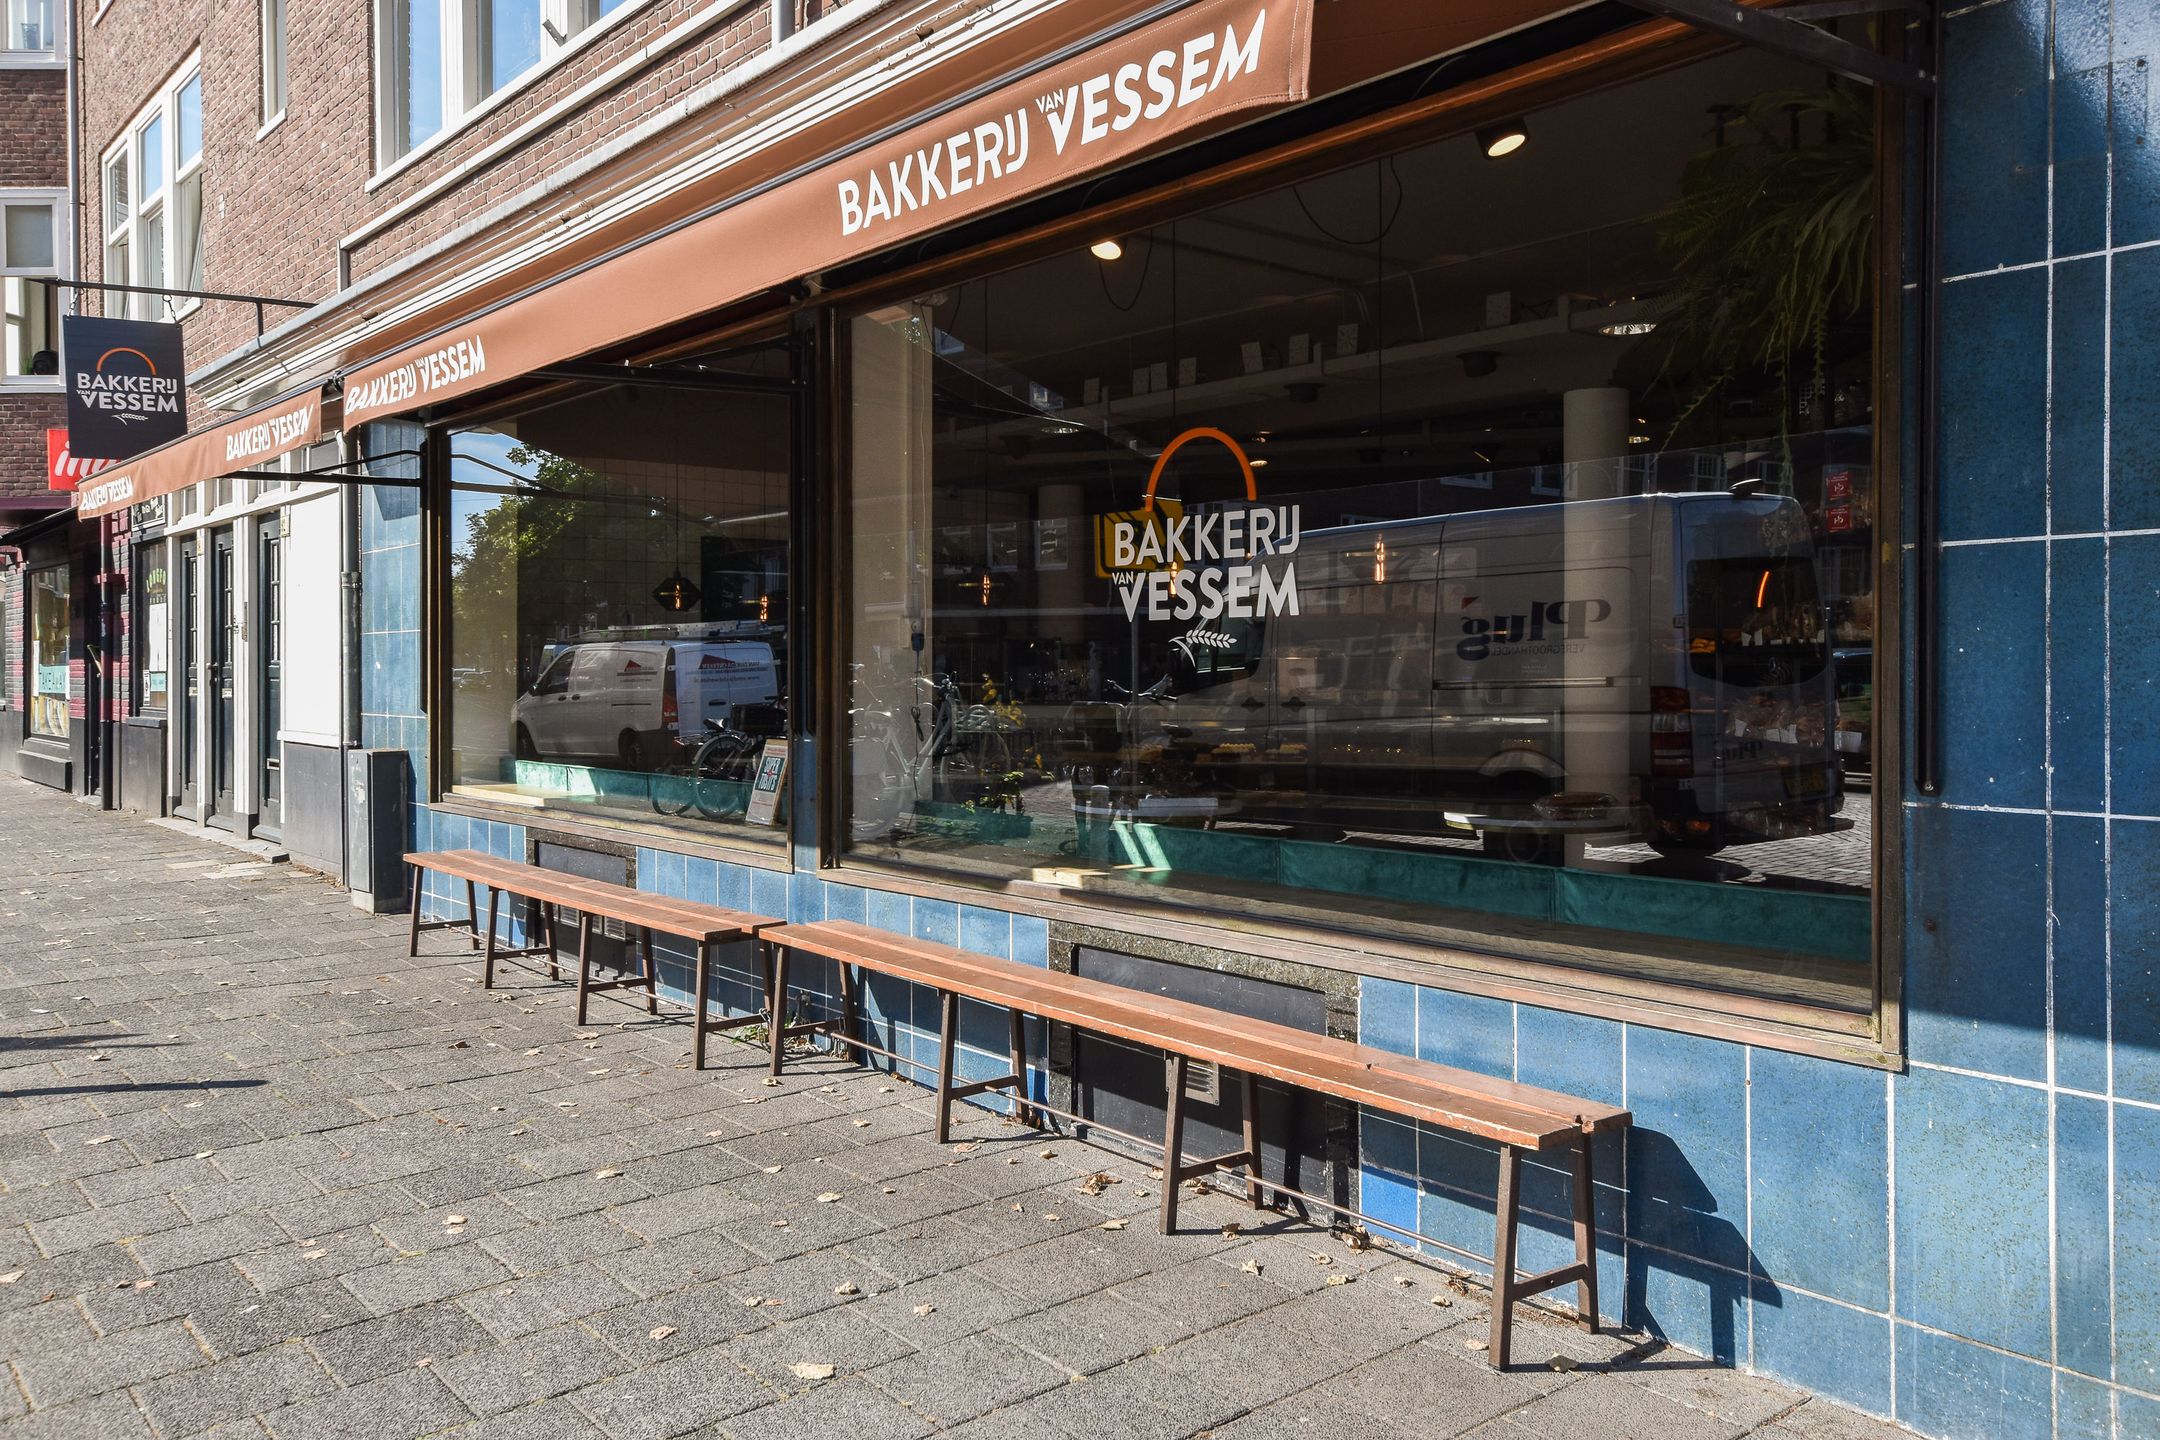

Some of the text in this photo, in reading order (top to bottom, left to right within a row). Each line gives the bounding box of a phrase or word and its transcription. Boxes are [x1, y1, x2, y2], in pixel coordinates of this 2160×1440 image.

[837, 9, 1266, 236] BAKKERIJ VAN VESSEM
[77, 373, 178, 394] BAKKERIJ
[81, 391, 179, 413] VESSEM
[344, 363, 417, 416] BAKKERIJ
[420, 335, 486, 393] VESSEM
[226, 422, 271, 461] BAKKERIJ
[1114, 504, 1300, 567] BAKKERIJ
[1111, 562, 1300, 623] VAN VESSEM
